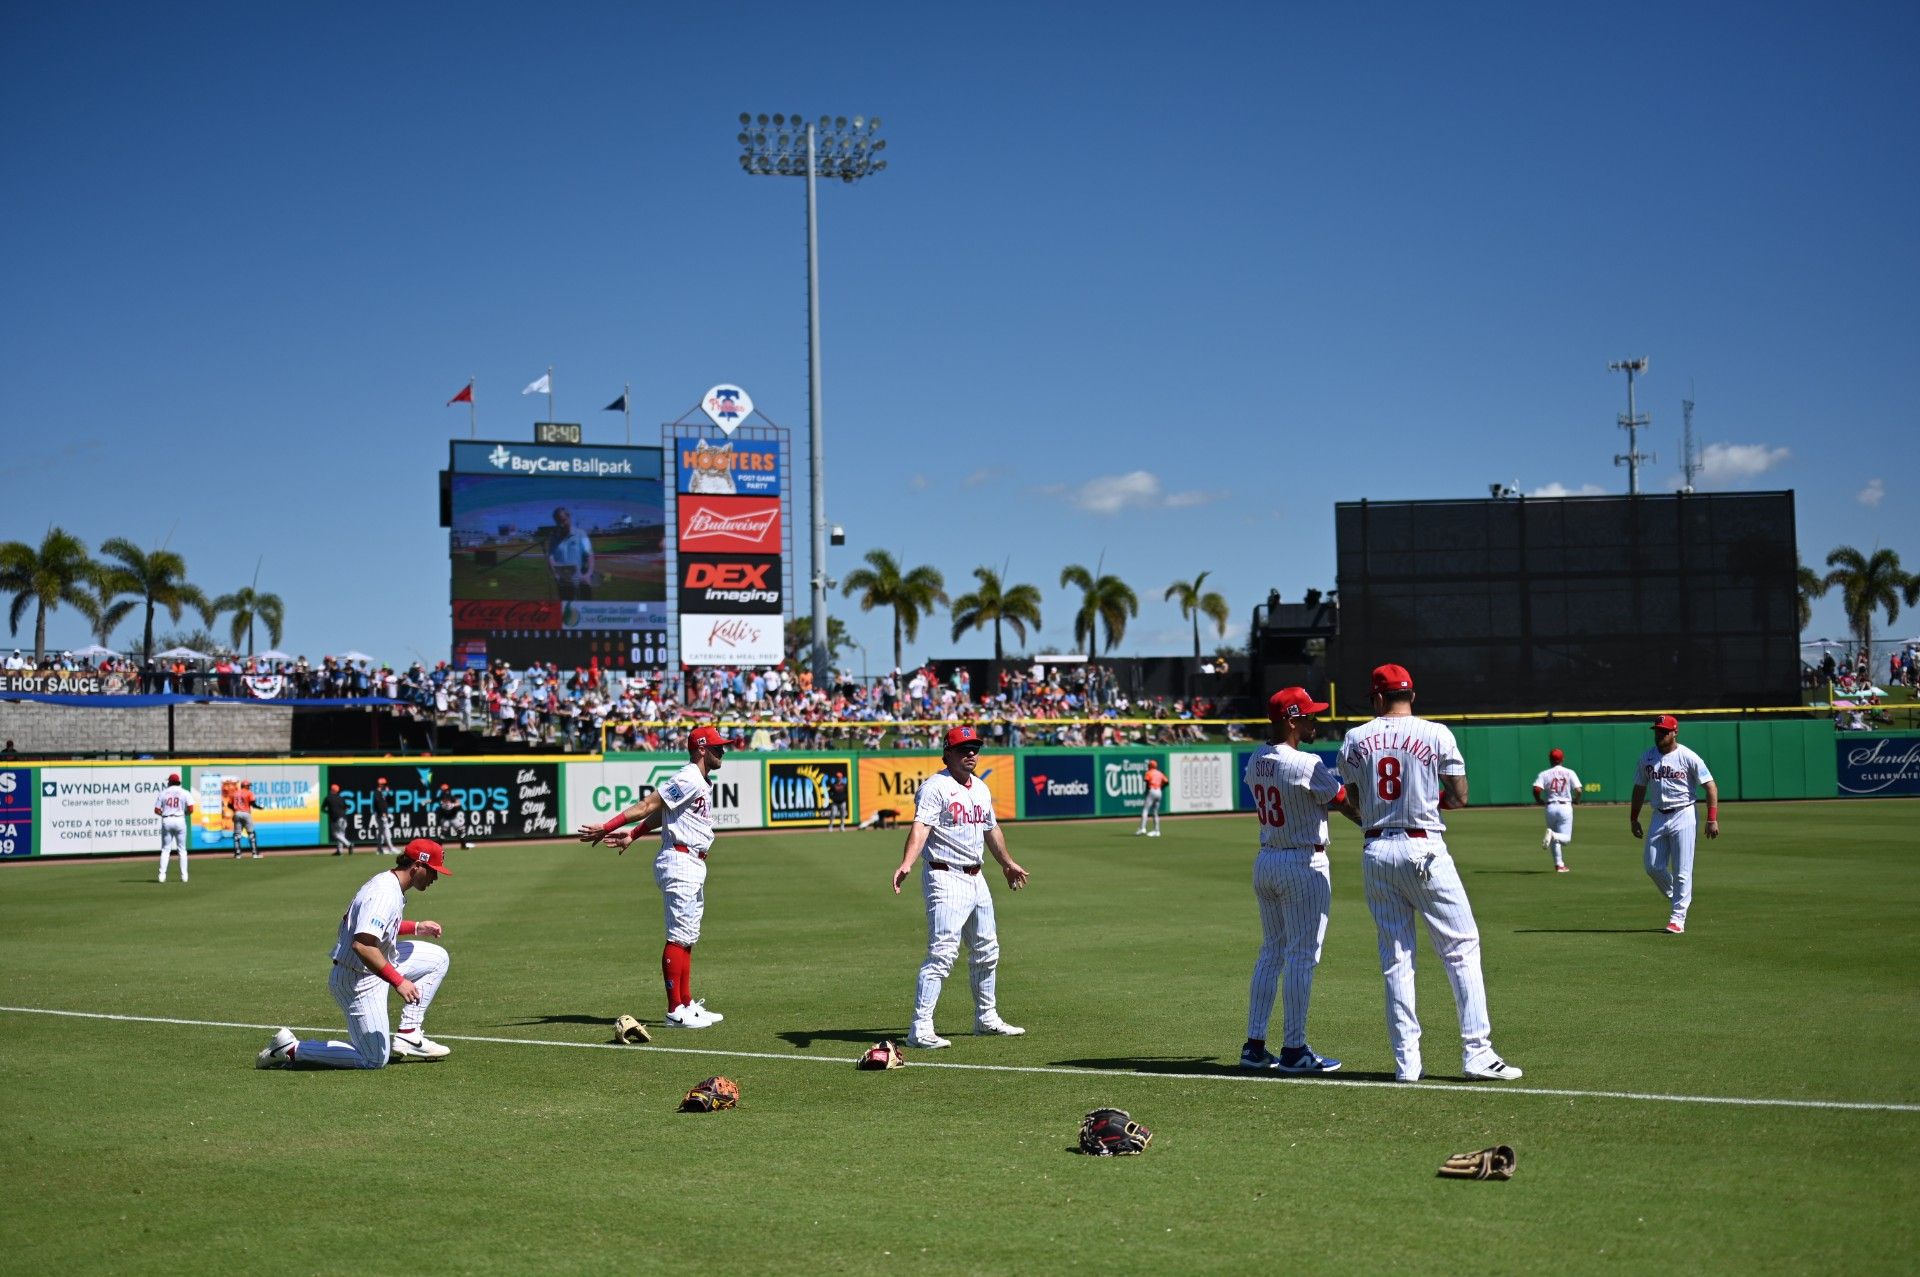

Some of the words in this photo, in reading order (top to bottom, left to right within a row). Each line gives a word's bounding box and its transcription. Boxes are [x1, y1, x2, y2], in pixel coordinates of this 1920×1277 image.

[542, 425, 580, 443] 12:40
[511, 456, 569, 474] BayCare
[572, 457, 632, 476] Ballpark
[683, 451, 776, 471] HOOTERS
[690, 515, 768, 531] Budweiser
[684, 563, 772, 589] DEX
[705, 588, 779, 603] imaging
[645, 633, 652, 644] S
[708, 619, 762, 647] Kelli's
[11, 677, 44, 692] HOT
[47, 678, 99, 693] SAUCE
[1347, 733, 1438, 769] CASTELLANOS
[516, 769, 537, 784] Eat.
[1256, 760, 1275, 778] SOSA
[1645, 764, 1688, 781] Phillies
[0, 772, 17, 793] S
[251, 781, 268, 794] EAL
[271, 781, 291, 794] ICED
[877, 771, 926, 796] Mai
[1105, 763, 1146, 797] Tim
[1377, 756, 1402, 802] 8
[1550, 778, 1568, 794] 47
[60, 782, 130, 795] WYNDHAM
[134, 782, 169, 794] GRAN
[519, 781, 551, 799] Drink.
[771, 775, 815, 810] CLEAR
[1047, 780, 1089, 796] Fanatics
[62, 799, 105, 807] Clearwater
[106, 798, 130, 807] Beach
[167, 797, 180, 809] 48
[255, 796, 273, 809] EAL
[521, 801, 546, 818] Stay
[1254, 784, 1285, 828] 33
[52, 819, 82, 829] VOTED
[95, 819, 112, 828] TOP
[114, 818, 123, 827] 10
[125, 818, 159, 827] RESORT
[353, 811, 411, 829] EACH
[427, 810, 509, 827] RSORT
[533, 816, 558, 833] Play
[95, 830, 118, 839] NAST
[450, 826, 492, 837] ACH
